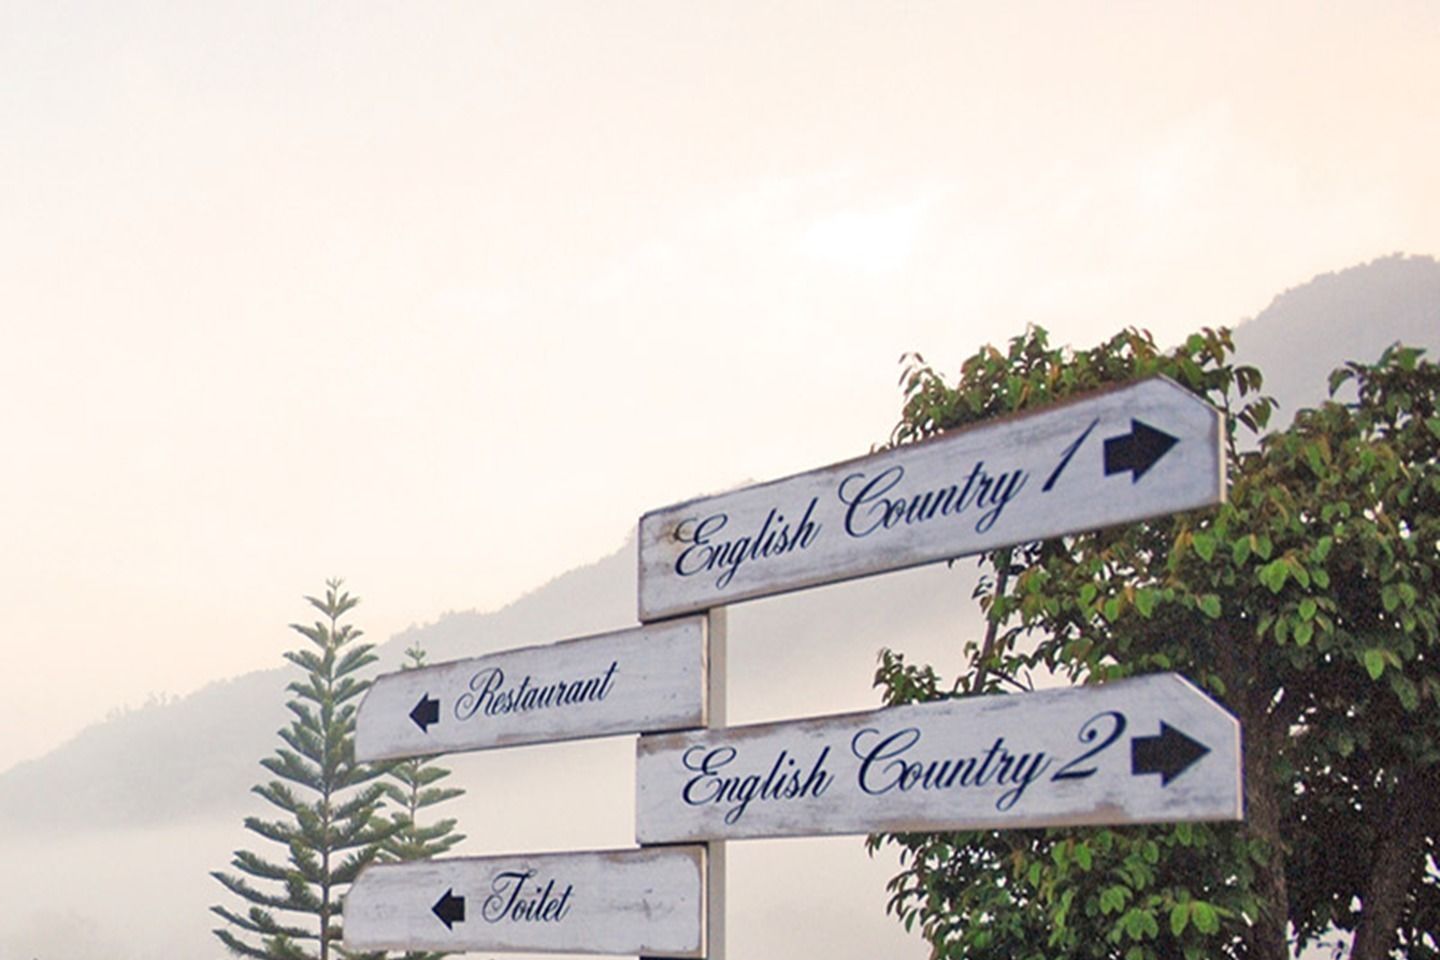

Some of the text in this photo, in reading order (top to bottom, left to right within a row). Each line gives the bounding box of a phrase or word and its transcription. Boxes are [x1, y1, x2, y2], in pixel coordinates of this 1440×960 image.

[673, 417, 1100, 589] English Country 1
[454, 661, 618, 721] Restaurant
[681, 710, 1128, 825] English Country 2
[482, 868, 574, 923] Toilet
